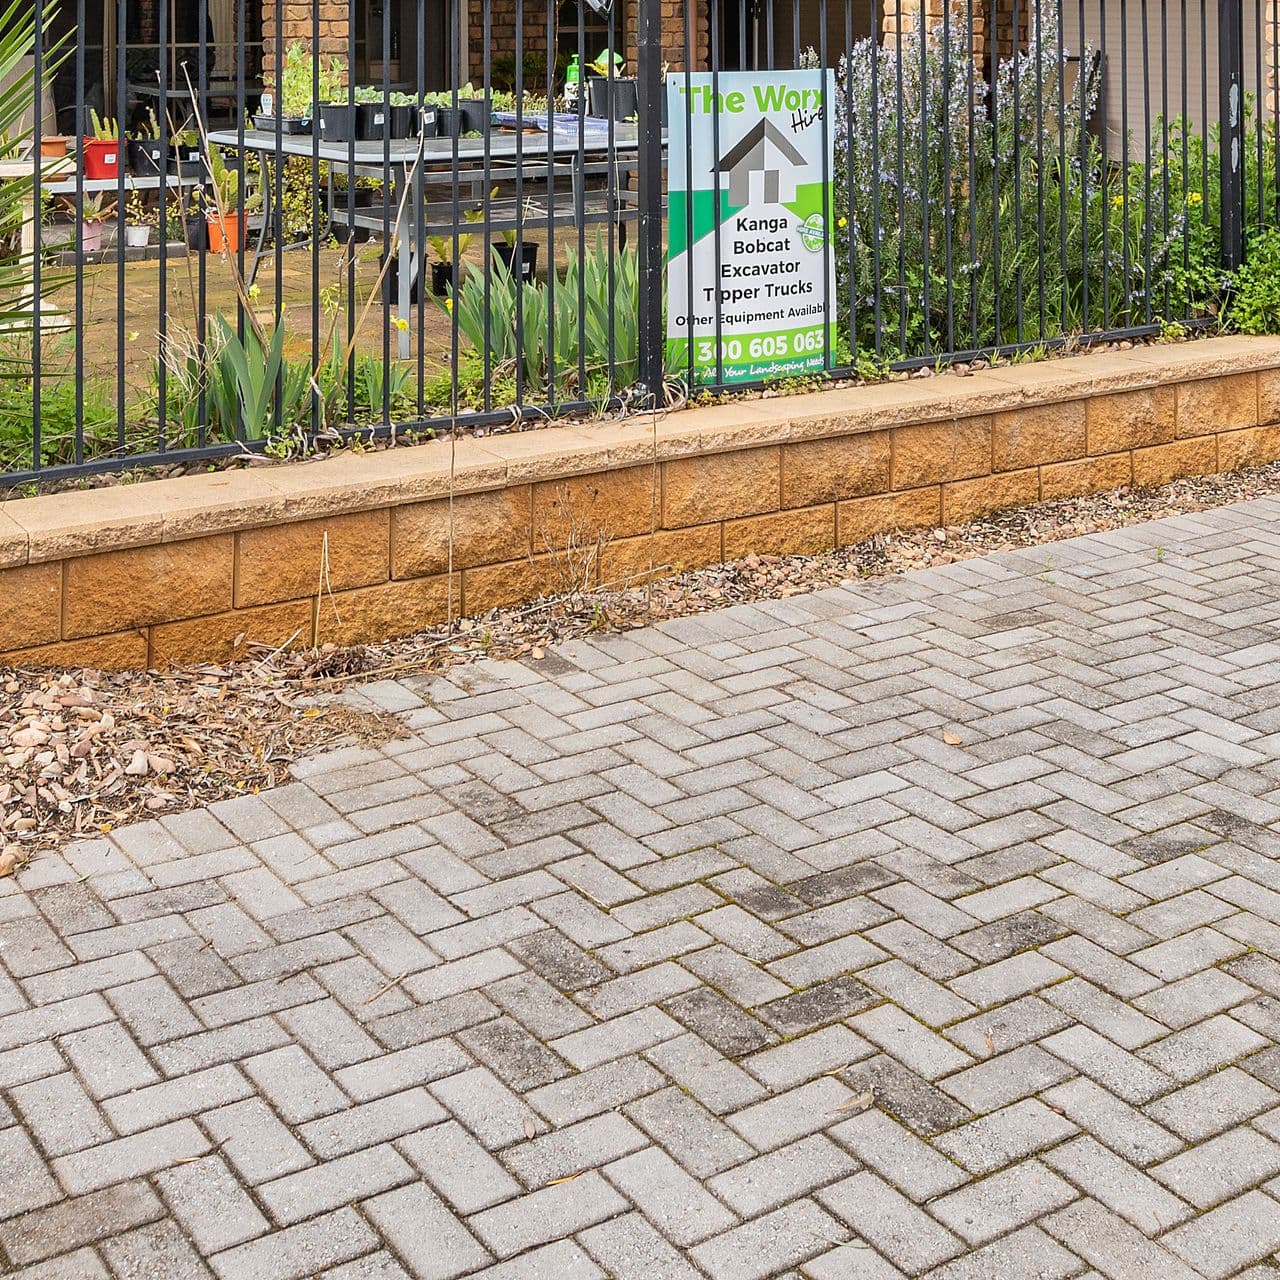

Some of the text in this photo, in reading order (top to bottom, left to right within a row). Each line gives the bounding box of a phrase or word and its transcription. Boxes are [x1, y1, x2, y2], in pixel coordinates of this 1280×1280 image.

[679, 84, 746, 114] The
[736, 217, 788, 233] Kanga
[733, 238, 791, 255] Bobcat
[721, 261, 801, 278] Excavator
[703, 279, 813, 304] Tpper Trucks
[675, 302, 828, 326] Oher Equipment Availabl
[749, 335, 788, 358] 605
[793, 329, 825, 352] 063
[724, 366, 747, 378] Your
[750, 360, 804, 376] Landscaping
